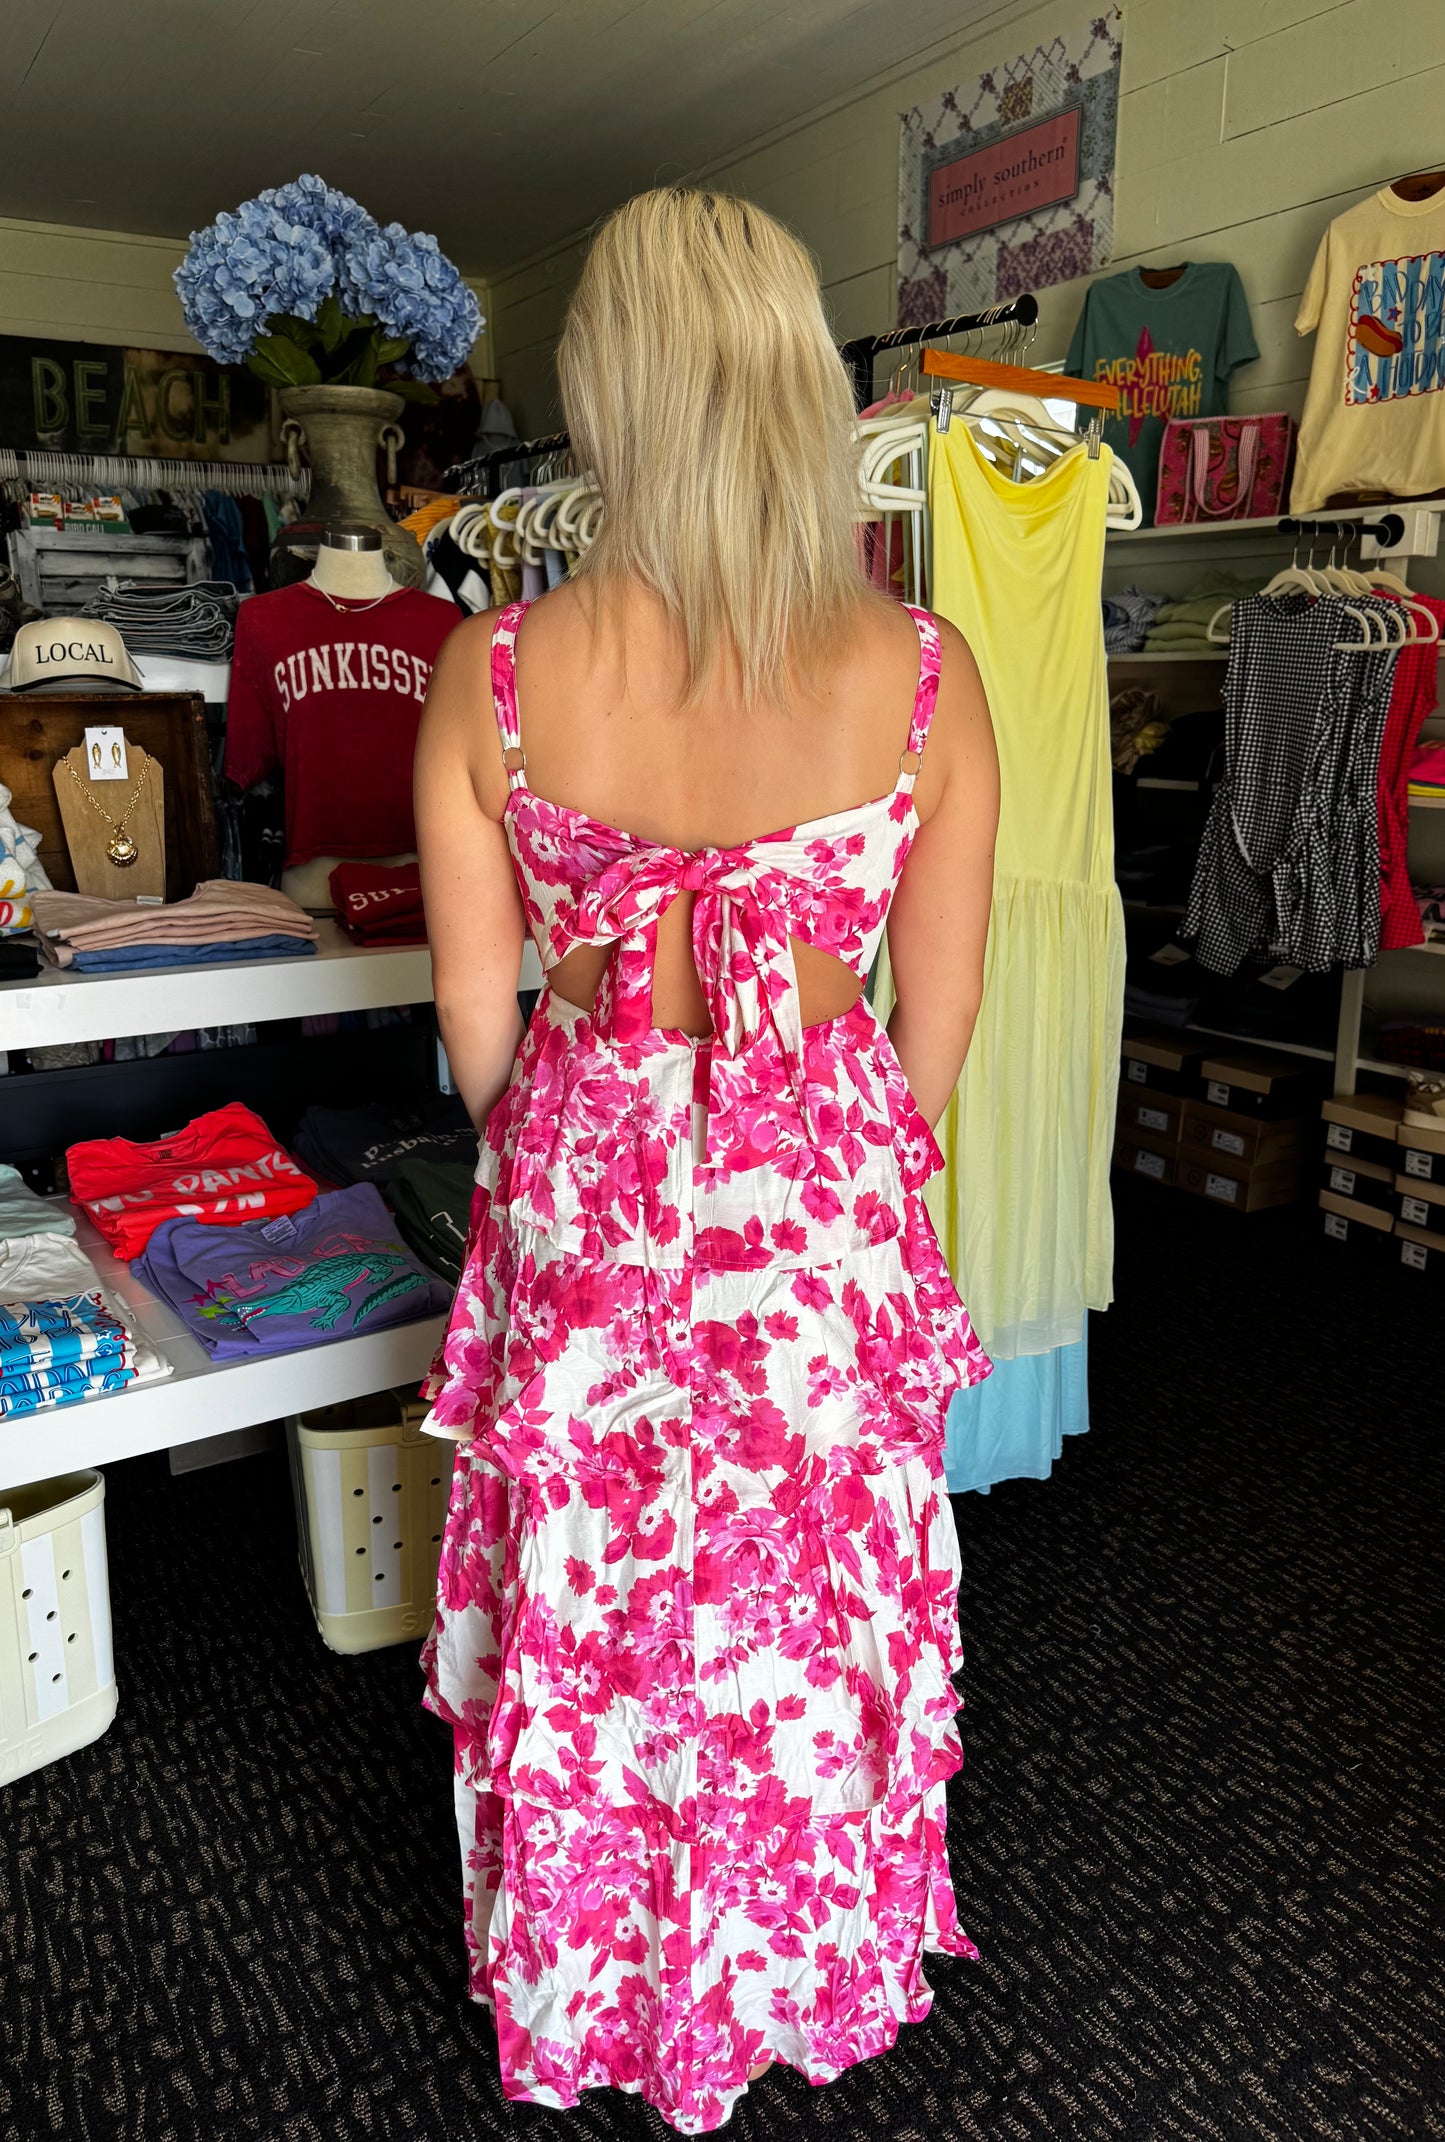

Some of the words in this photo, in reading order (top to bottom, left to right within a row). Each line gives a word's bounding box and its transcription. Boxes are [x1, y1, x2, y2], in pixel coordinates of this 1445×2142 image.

[937, 172, 987, 208] simply
[31, 356, 231, 446] BEACH
[35, 642, 114, 664] LOCAL
[275, 642, 434, 713] SUNKISSE
[171, 1151, 302, 1196] PANTS
